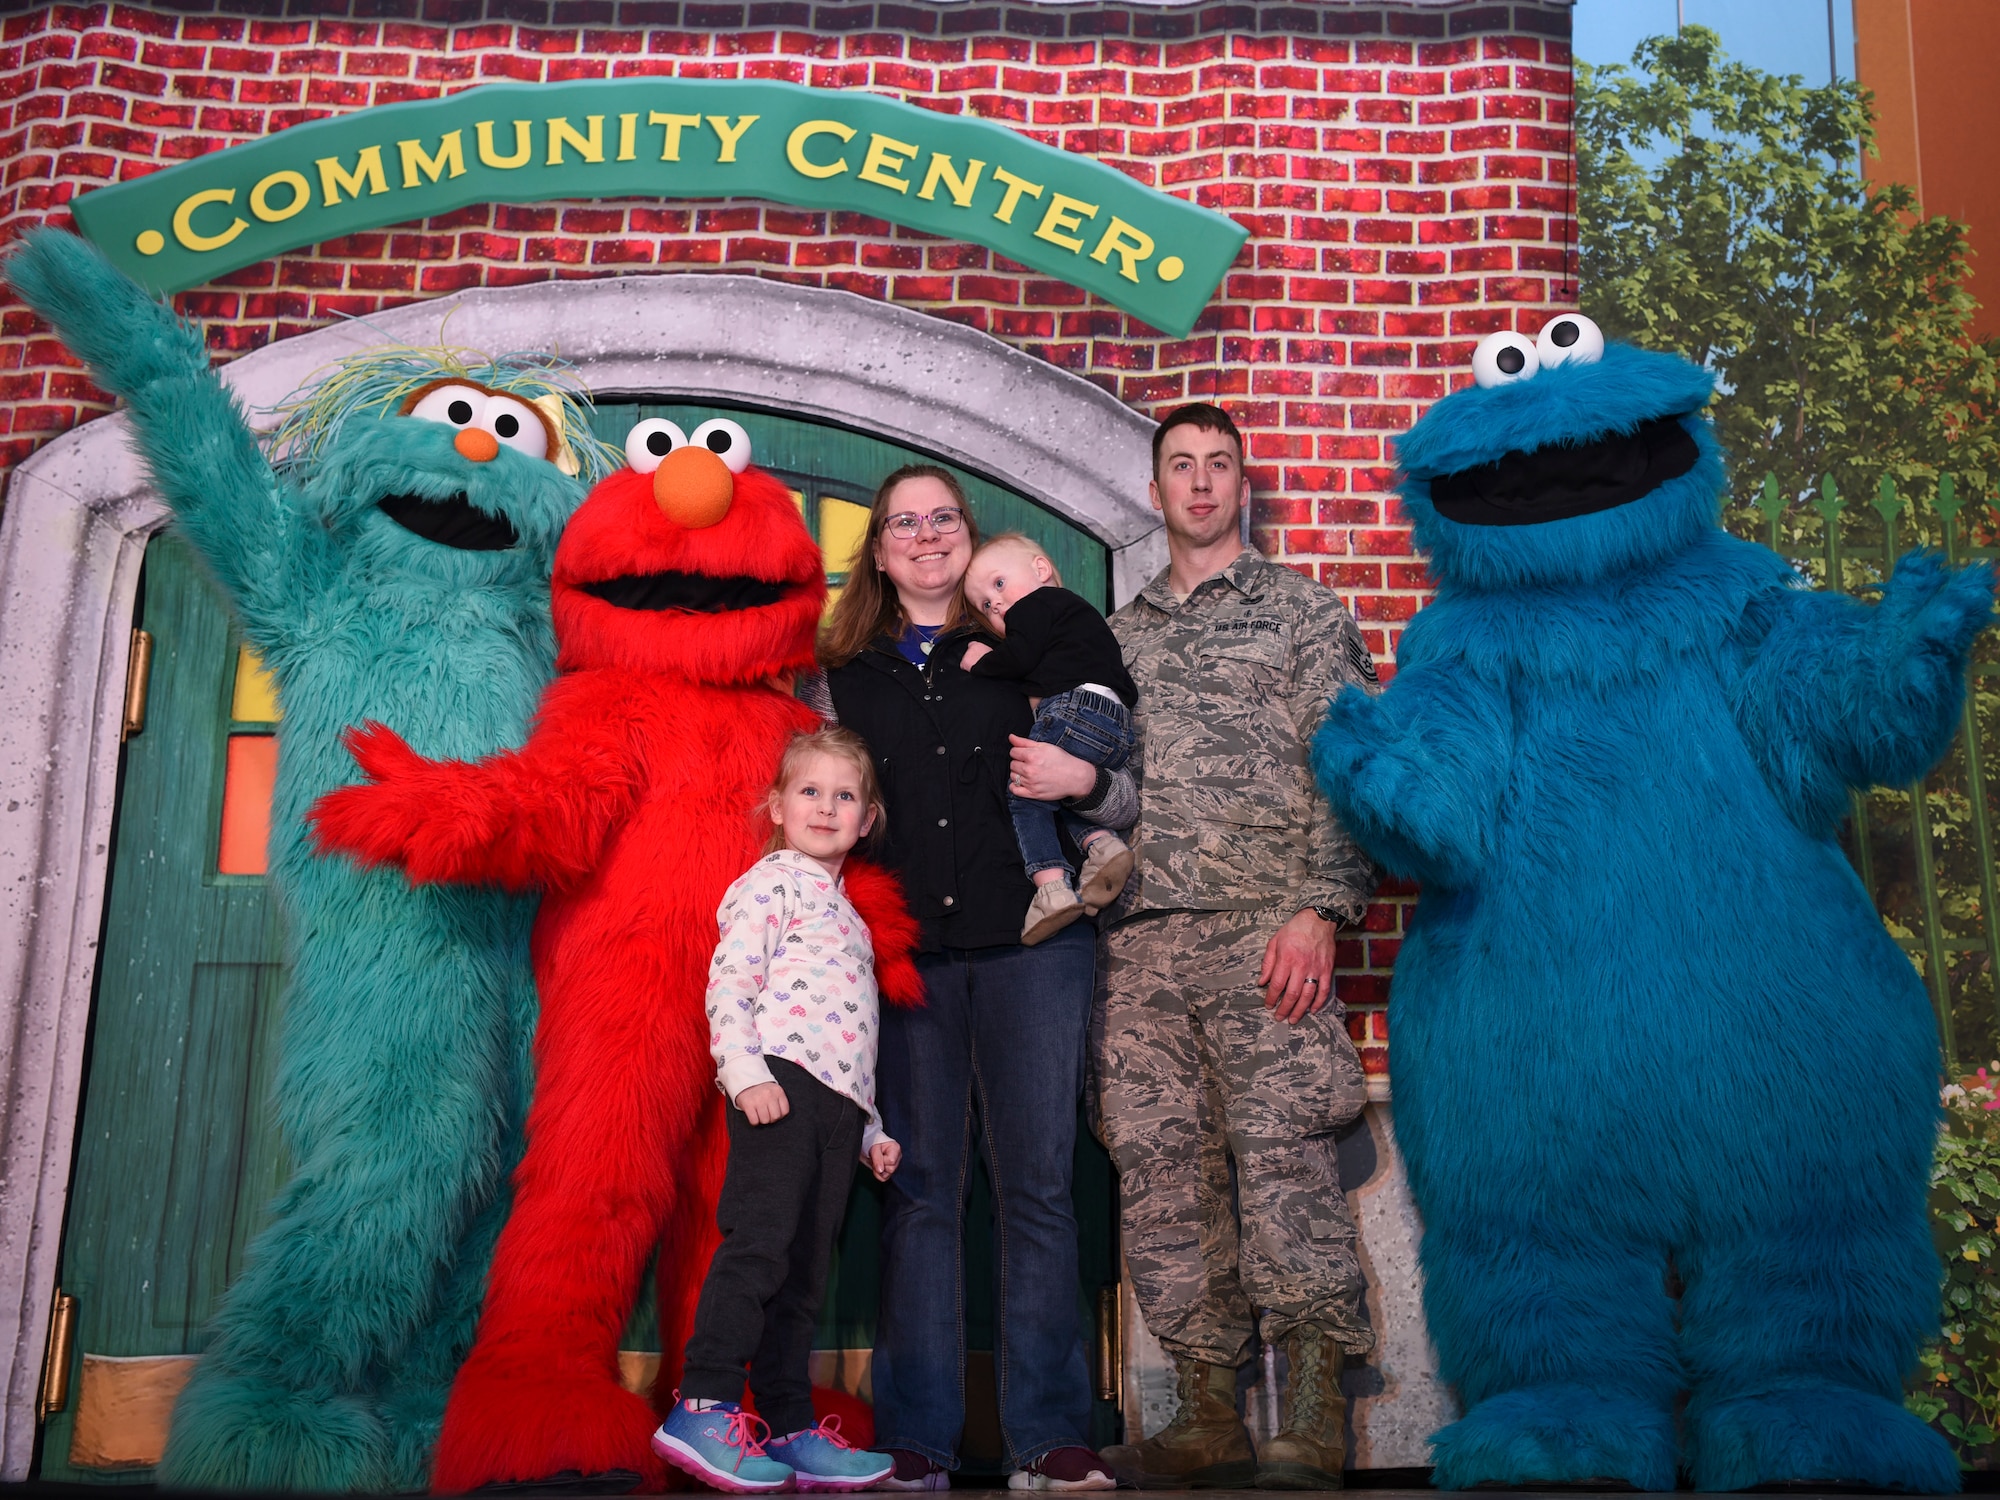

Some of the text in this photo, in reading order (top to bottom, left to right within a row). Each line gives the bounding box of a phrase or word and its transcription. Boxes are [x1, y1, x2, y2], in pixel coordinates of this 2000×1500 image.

[173, 112, 1155, 283] COMMUNITY CENTER
[1232, 622, 1248, 630] AIR
[1251, 620, 1282, 634] FORCE
